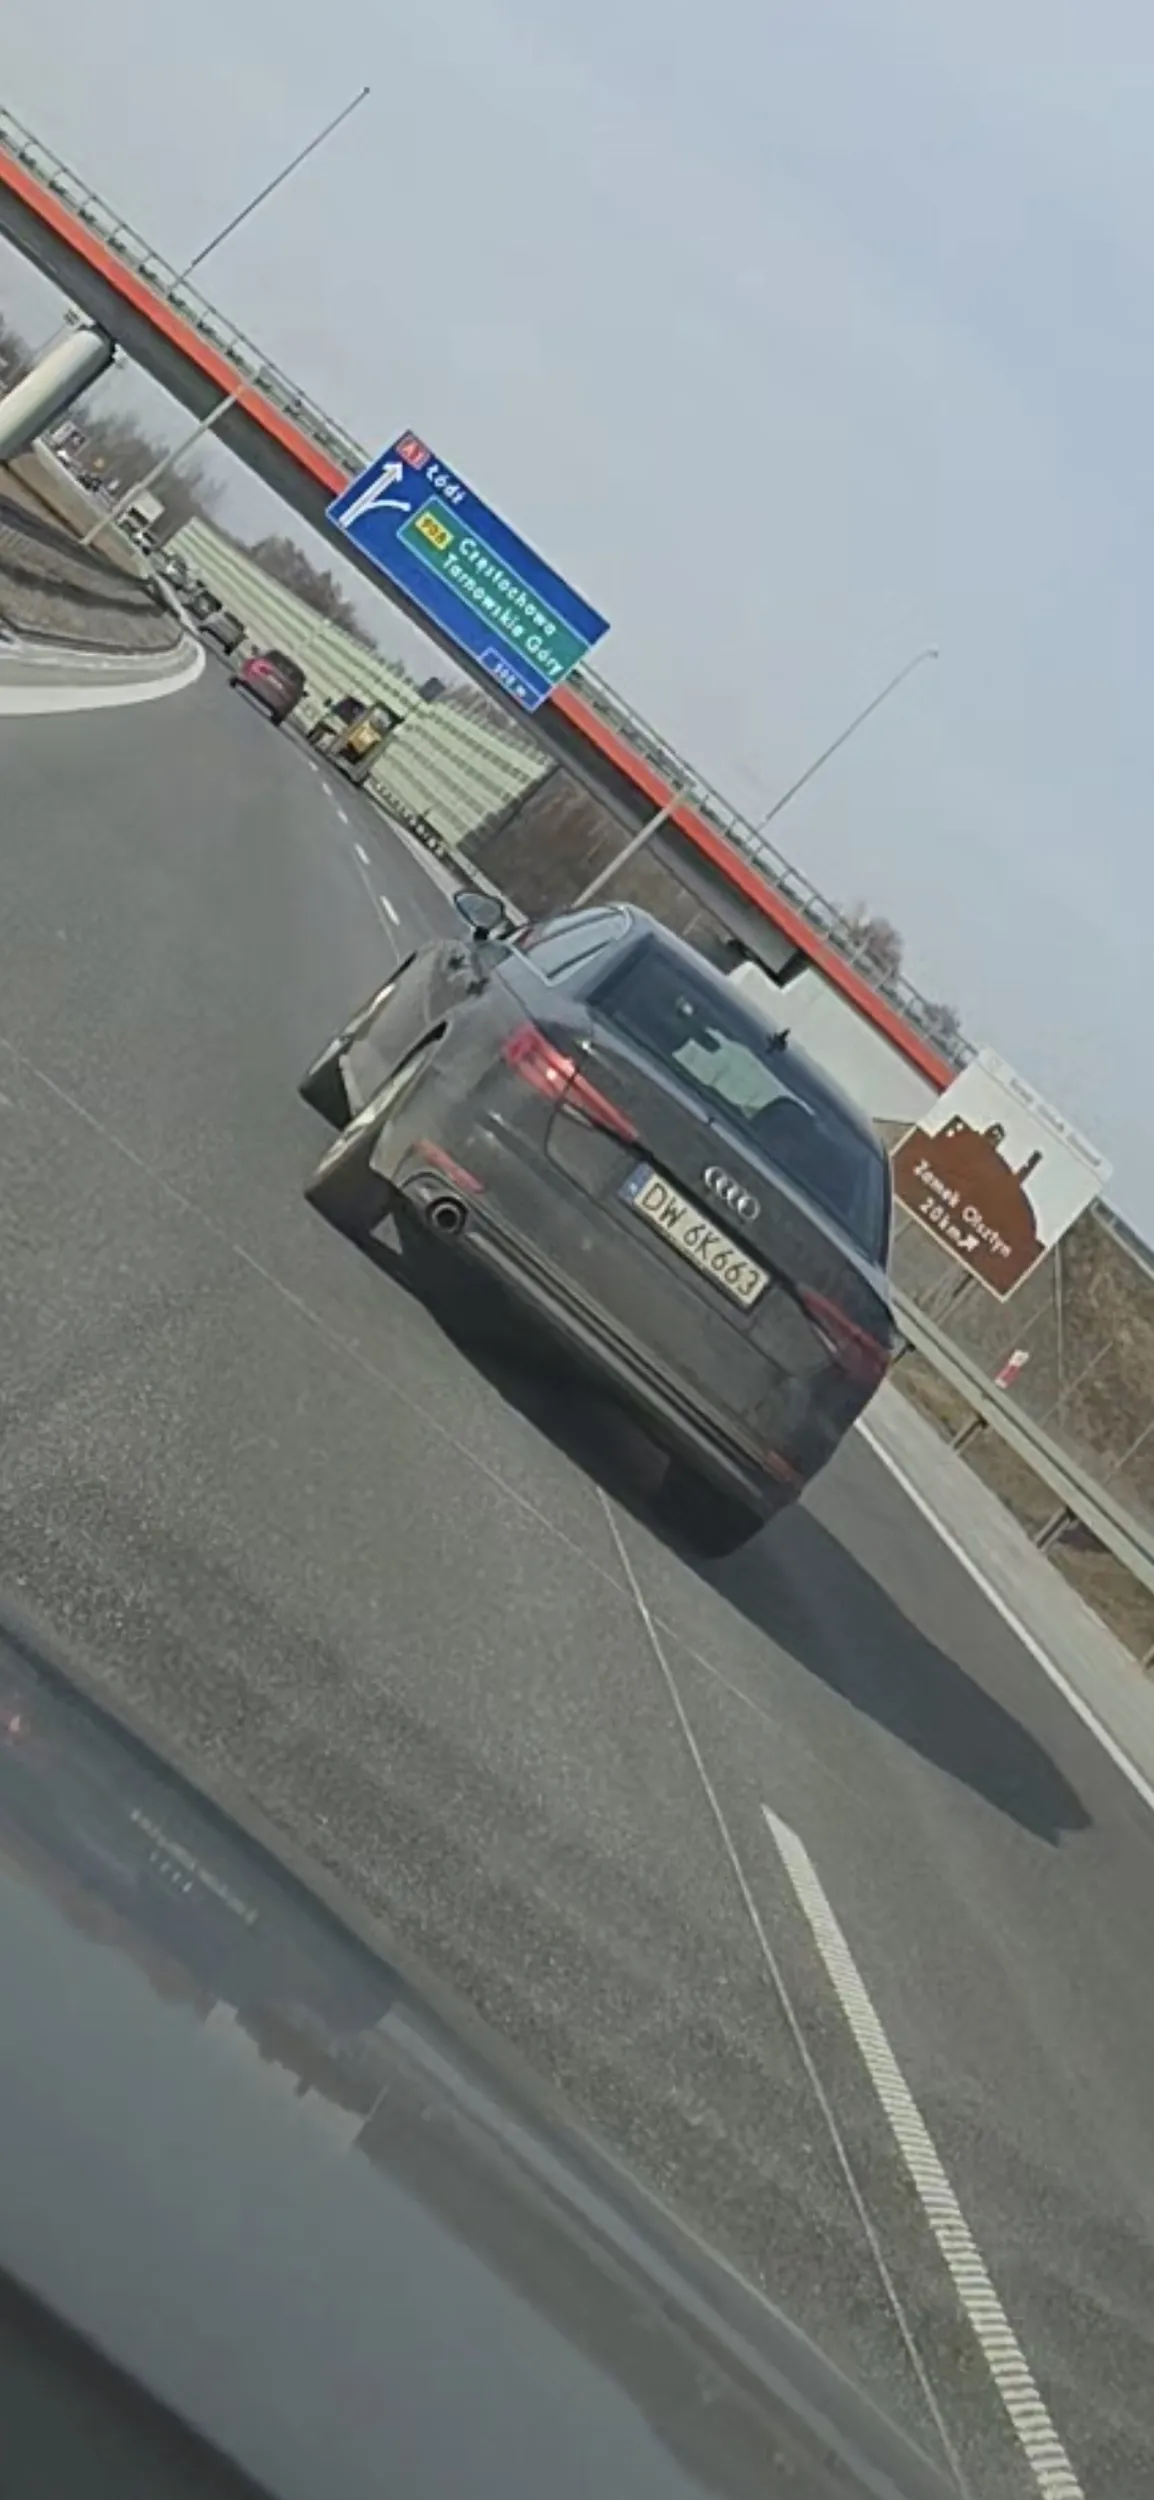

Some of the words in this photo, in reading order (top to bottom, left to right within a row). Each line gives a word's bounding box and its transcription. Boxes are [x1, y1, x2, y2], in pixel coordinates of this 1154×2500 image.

[442, 553, 523, 638] Tarnowskie
[525, 635, 565, 676] Góry
[459, 537, 556, 636] Częstochowa
[642, 1182, 687, 1228] DW
[683, 1224, 760, 1296] 6K663
[913, 1159, 960, 1207] Zamek
[961, 1205, 1012, 1258] Olsztyn
